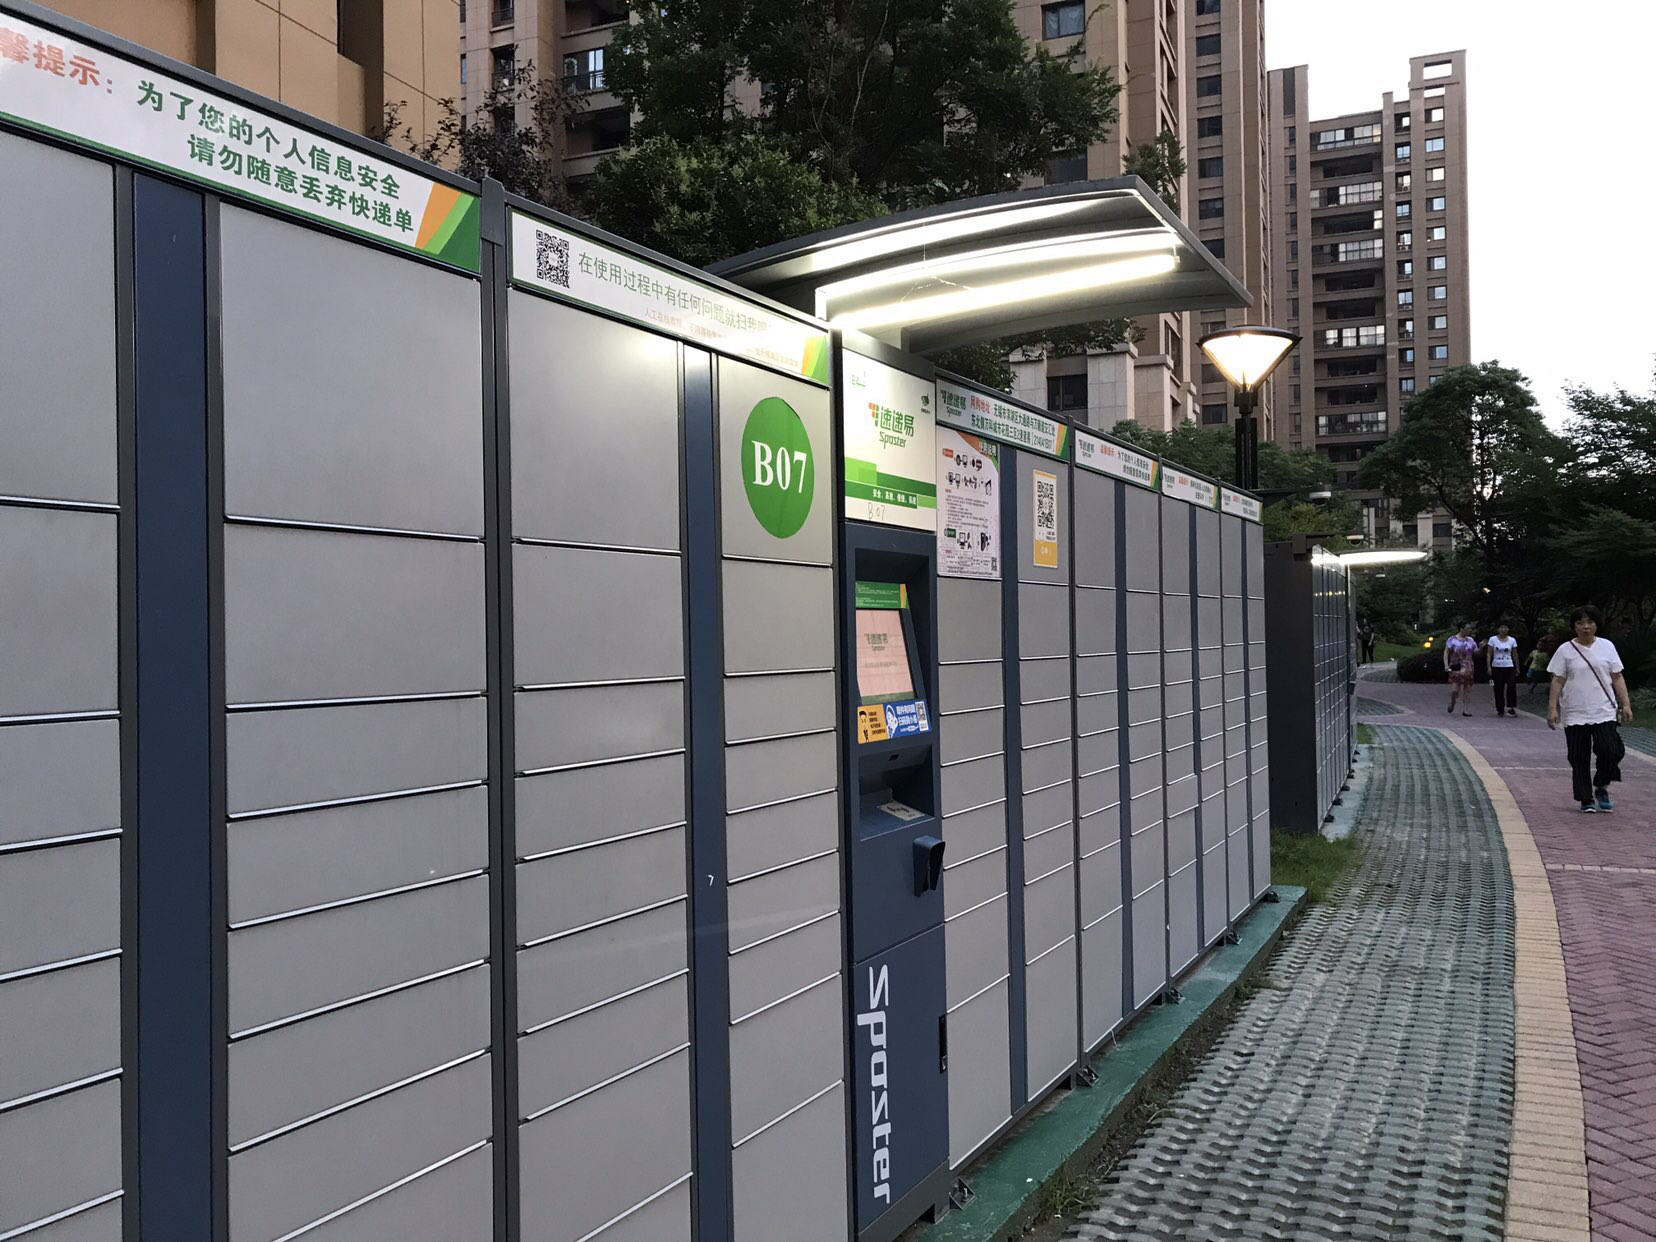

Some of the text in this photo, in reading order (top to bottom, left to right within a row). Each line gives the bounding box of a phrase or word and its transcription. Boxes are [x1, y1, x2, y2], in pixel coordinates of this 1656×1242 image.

[137, 79, 401, 199] 为了您的个人信息安全
[187, 133, 414, 232] 请勿随意丢弃快递单
[880, 405, 915, 438] 速递易
[751, 440, 808, 494] B07
